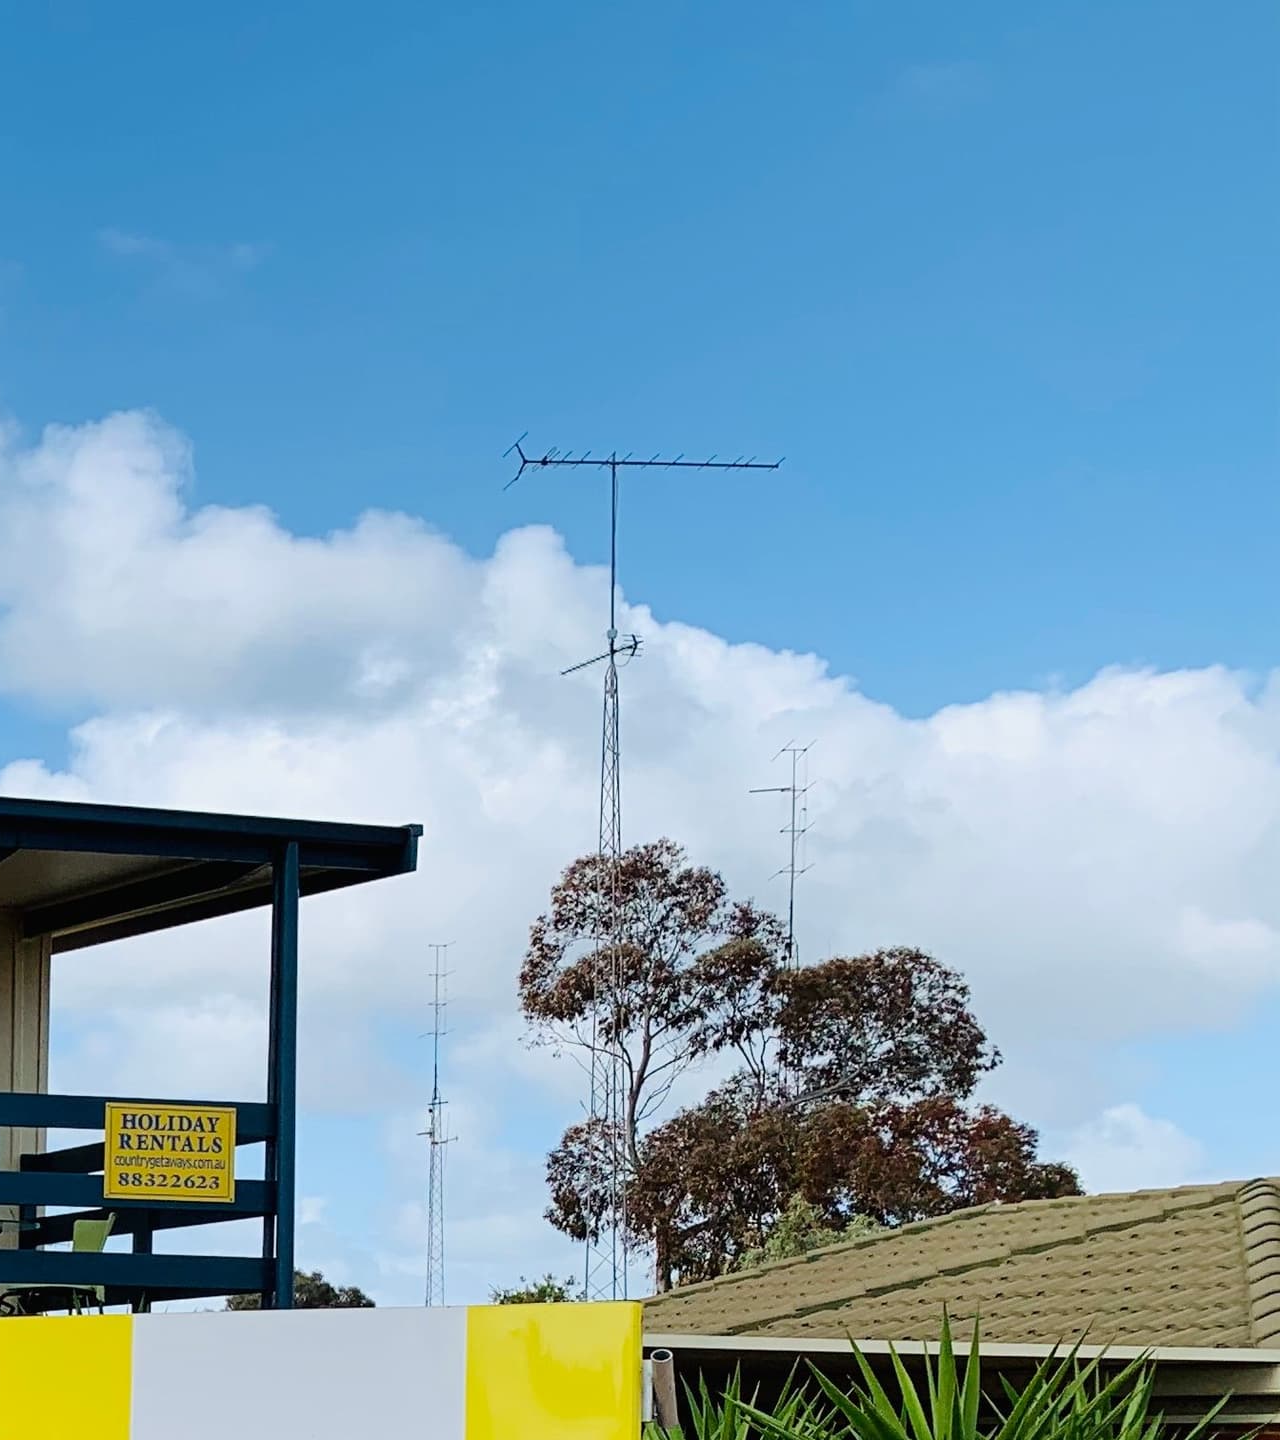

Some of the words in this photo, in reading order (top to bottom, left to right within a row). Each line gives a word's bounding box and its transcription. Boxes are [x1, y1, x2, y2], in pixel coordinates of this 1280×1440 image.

[121, 1113, 220, 1133] HOLIDAY
[118, 1133, 223, 1153] RENTALS
[114, 1155, 226, 1170] countrygetaways.com.au
[118, 1172, 220, 1190] 88322623
